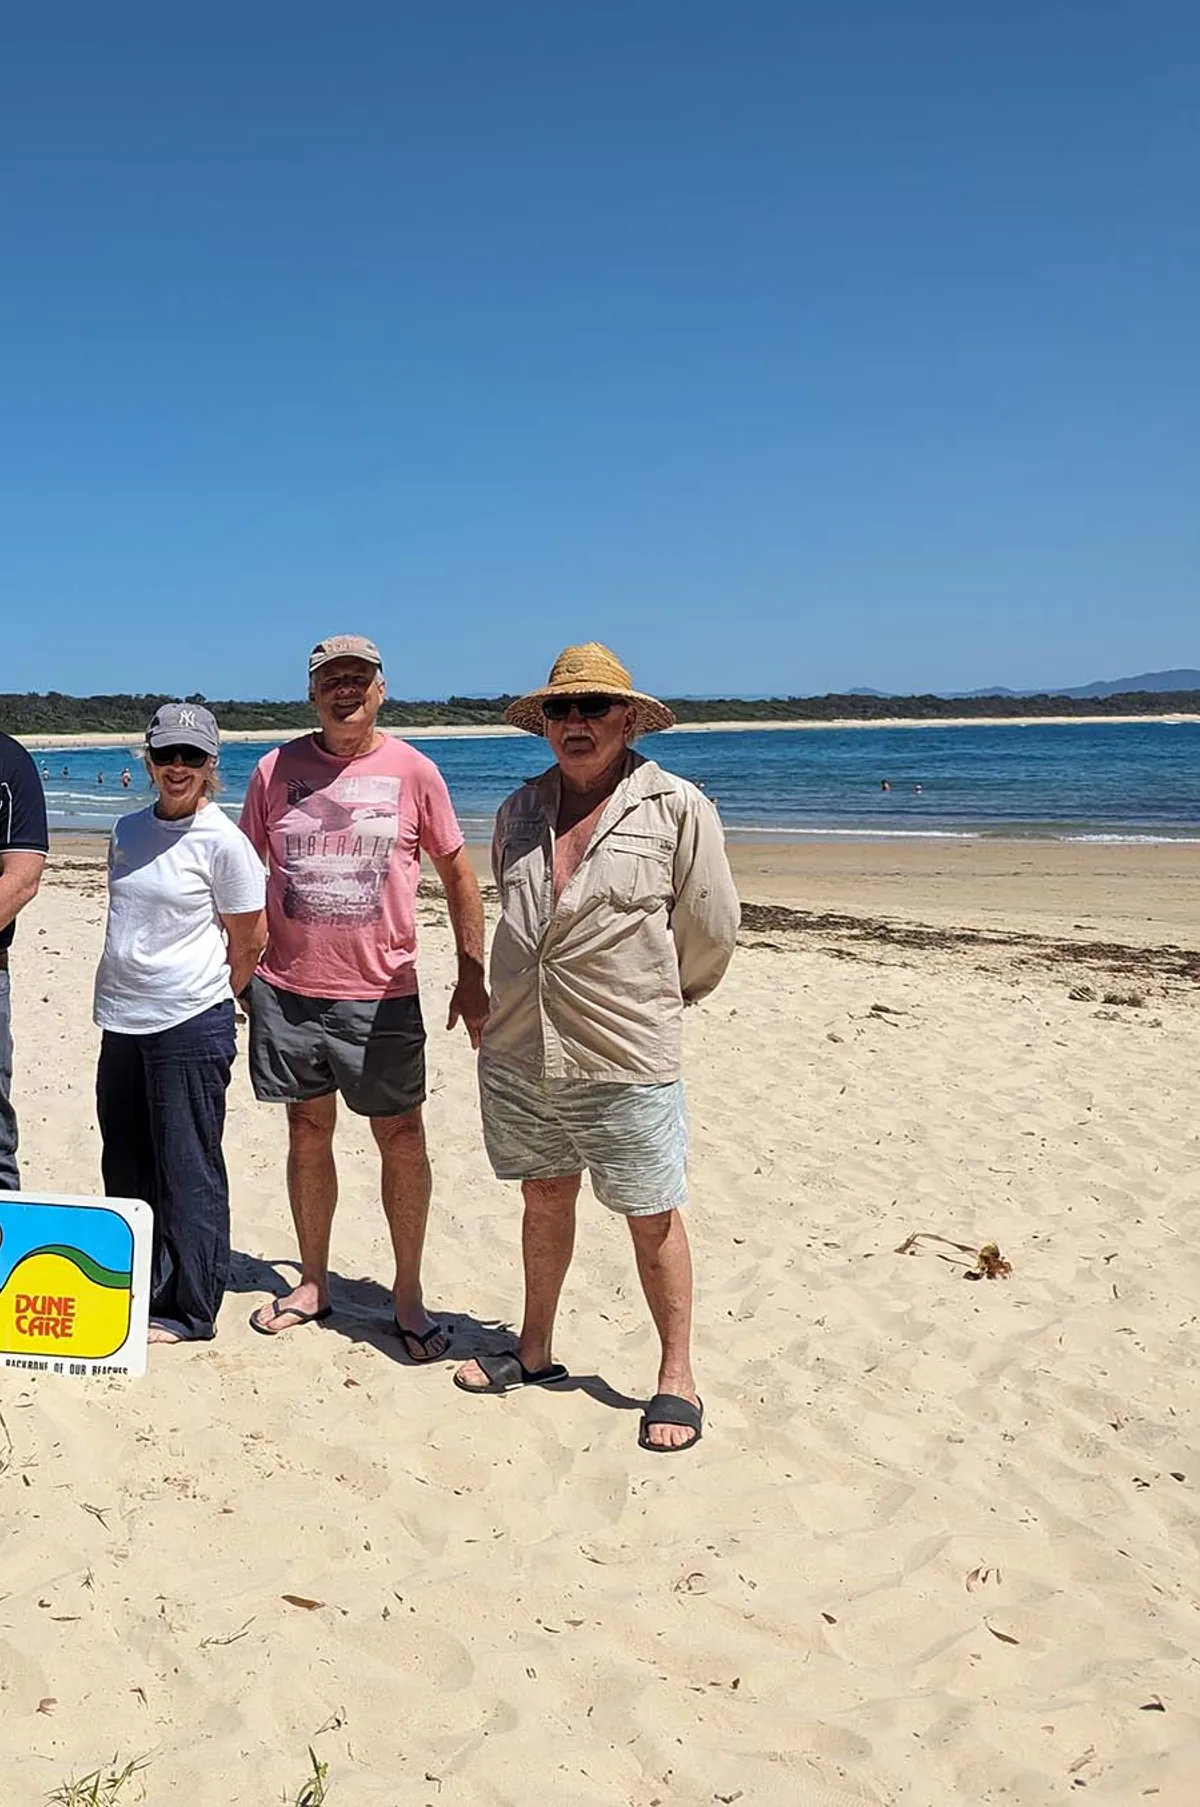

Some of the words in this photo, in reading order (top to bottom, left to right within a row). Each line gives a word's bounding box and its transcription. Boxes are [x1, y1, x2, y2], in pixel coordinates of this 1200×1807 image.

[284, 834, 395, 858] LIBERATE
[15, 1293, 76, 1318] DUNE
[15, 1314, 74, 1340] CARE
[53, 1362, 64, 1374] OF
[69, 1363, 87, 1376] OUR
